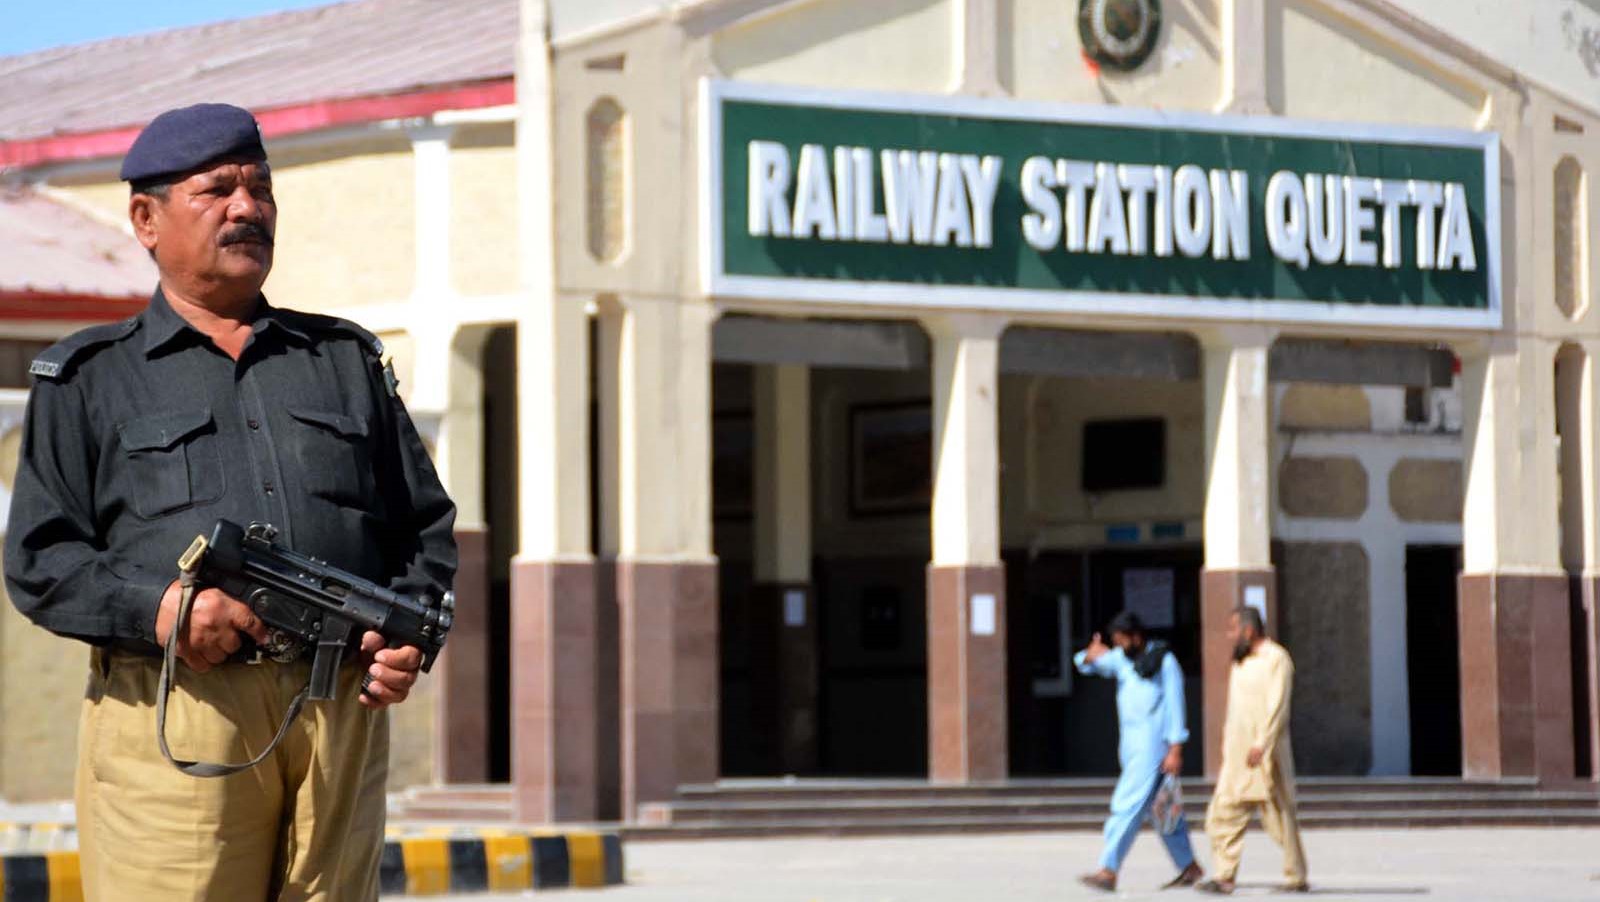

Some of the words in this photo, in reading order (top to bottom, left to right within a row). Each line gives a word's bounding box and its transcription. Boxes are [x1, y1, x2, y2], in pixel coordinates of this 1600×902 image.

[748, 140, 1001, 248] RAILWAY
[1020, 156, 1251, 260] STATION
[1265, 170, 1477, 271] QUETTA
